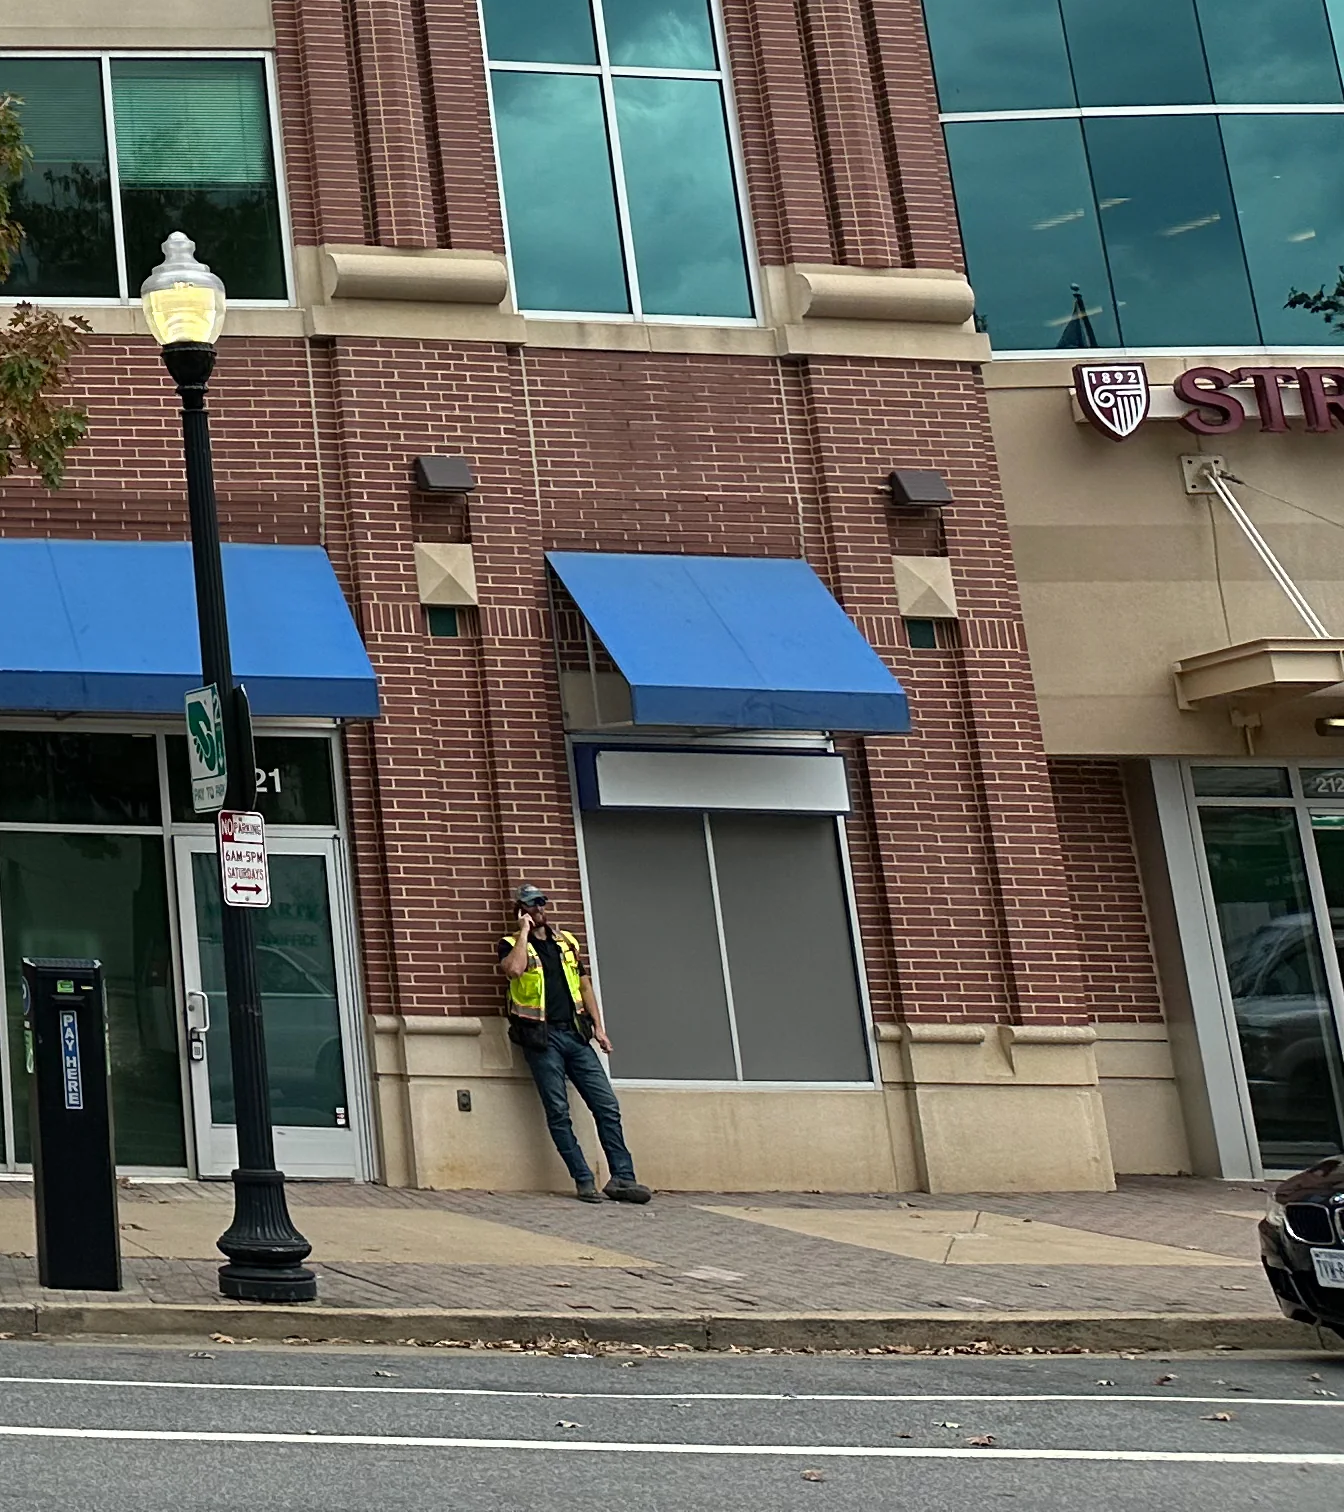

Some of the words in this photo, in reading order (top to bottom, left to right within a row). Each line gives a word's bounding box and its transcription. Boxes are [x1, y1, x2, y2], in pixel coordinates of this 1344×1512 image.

[1089, 372, 1137, 384] 1892
[206, 786, 215, 799] TO
[221, 818, 232, 836] NO
[233, 822, 262, 835] PARKING
[226, 850, 263, 863] 6AM-5PM
[227, 867, 264, 880] SATURDAYS
[63, 1014, 74, 1052] PAY
[66, 1056, 79, 1104] HERE
